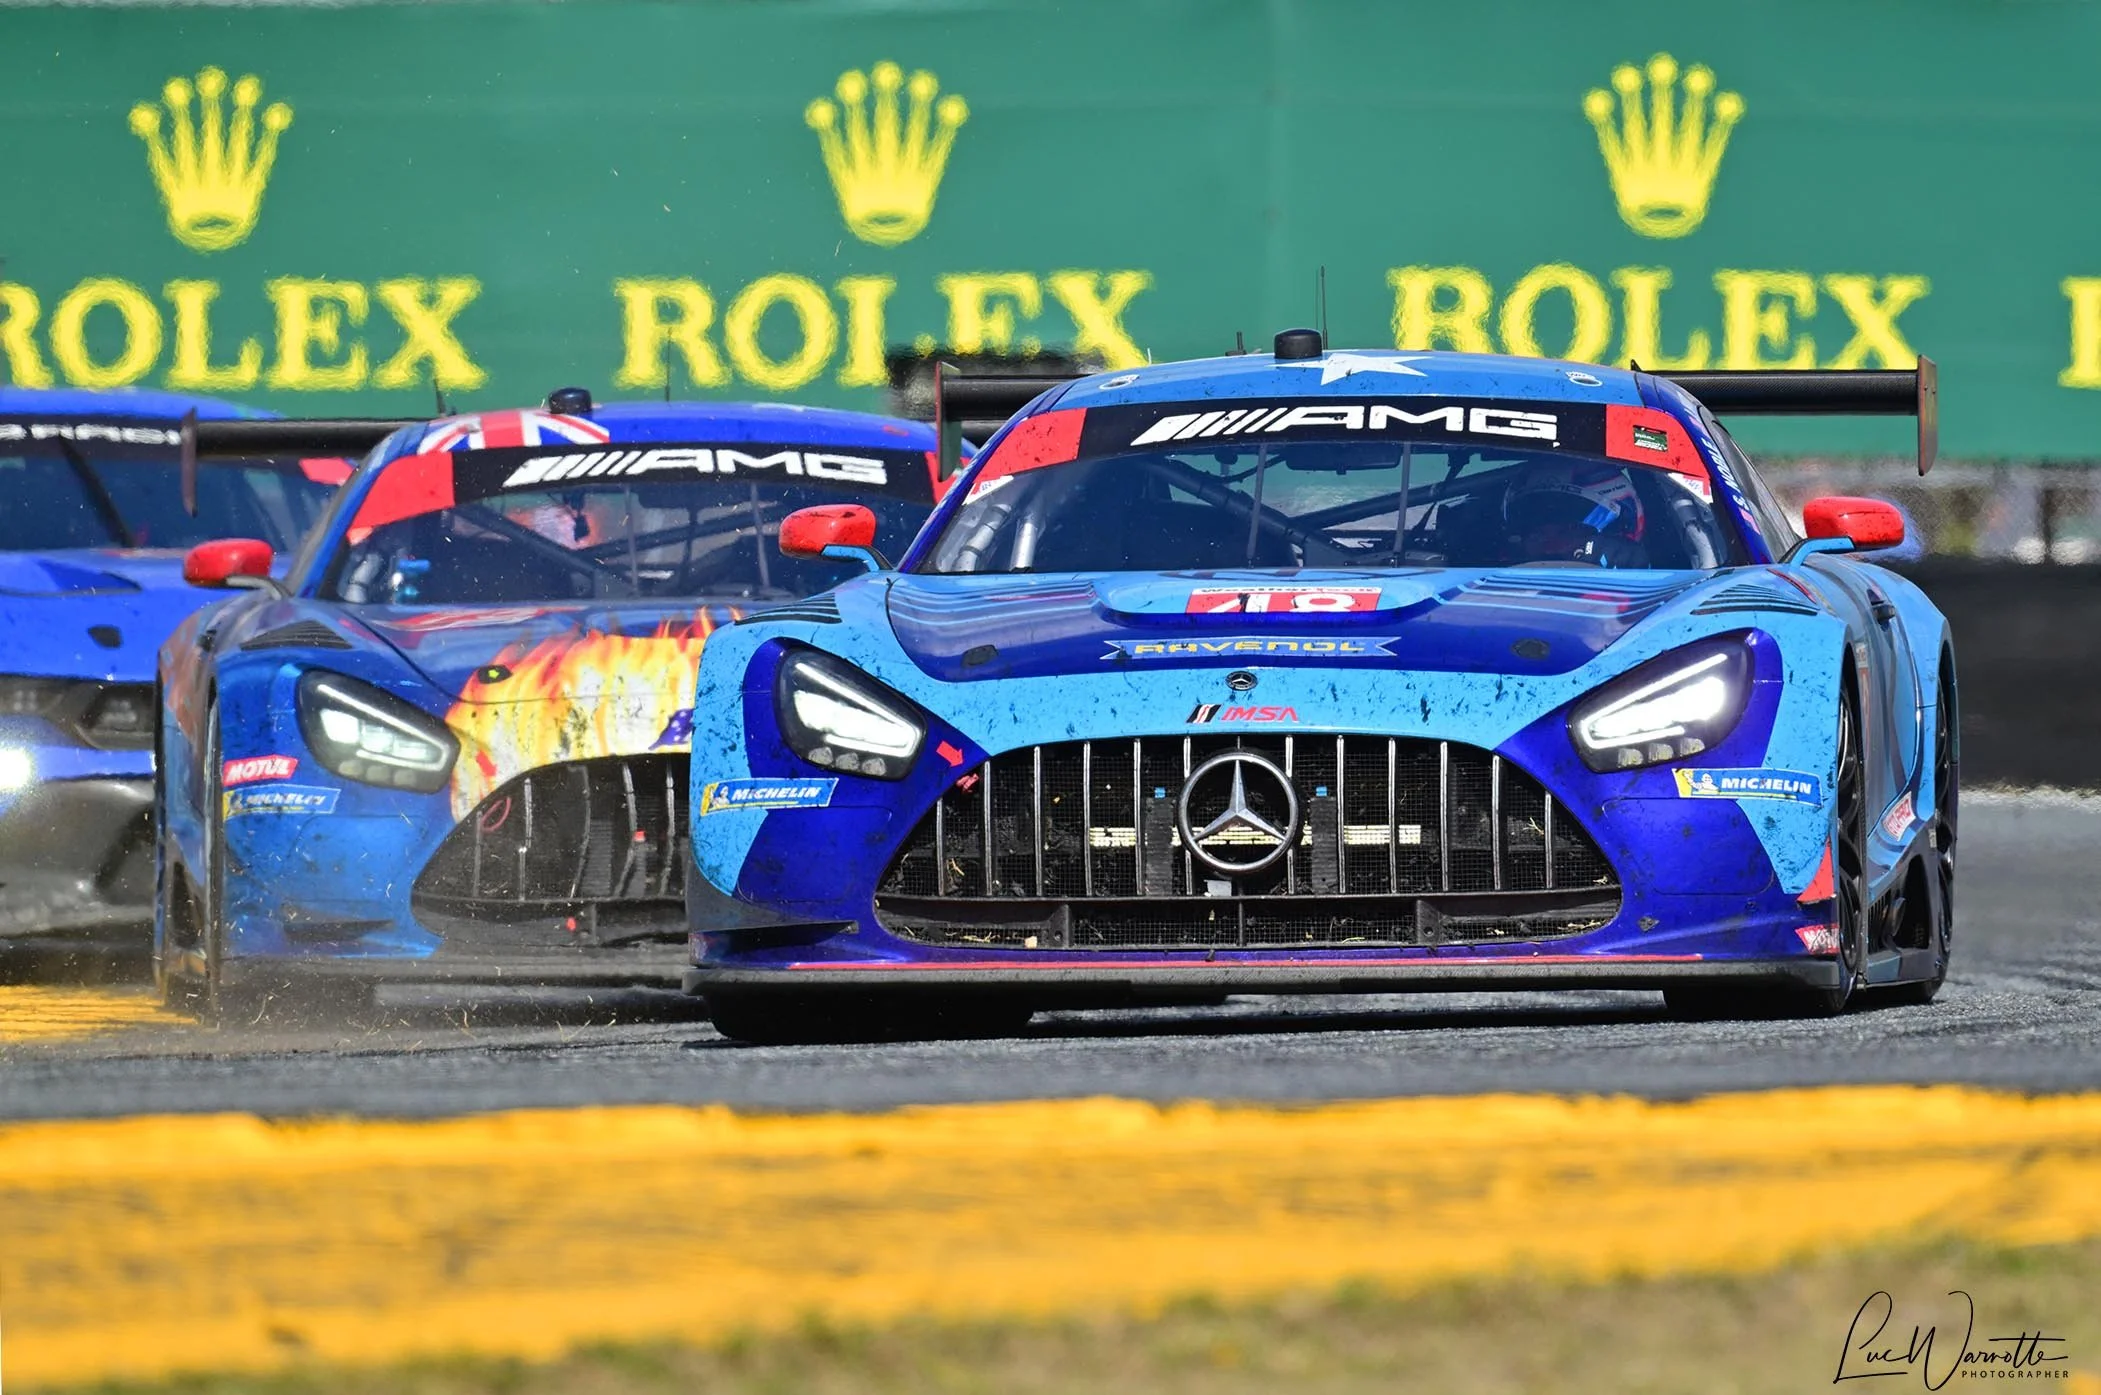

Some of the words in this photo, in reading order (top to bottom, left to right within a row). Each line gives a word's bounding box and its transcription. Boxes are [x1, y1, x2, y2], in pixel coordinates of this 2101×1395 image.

[1386, 262, 1930, 371] ROLEX
[1264, 405, 1558, 440] AMG
[625, 449, 888, 485] AMG
[1134, 640, 1366, 655] RAVENOL
[1221, 706, 1300, 722] IMSA
[226, 758, 291, 782] MOTUL
[731, 786, 822, 802] MICHELIN
[1721, 776, 1813, 795] MICHELIN
